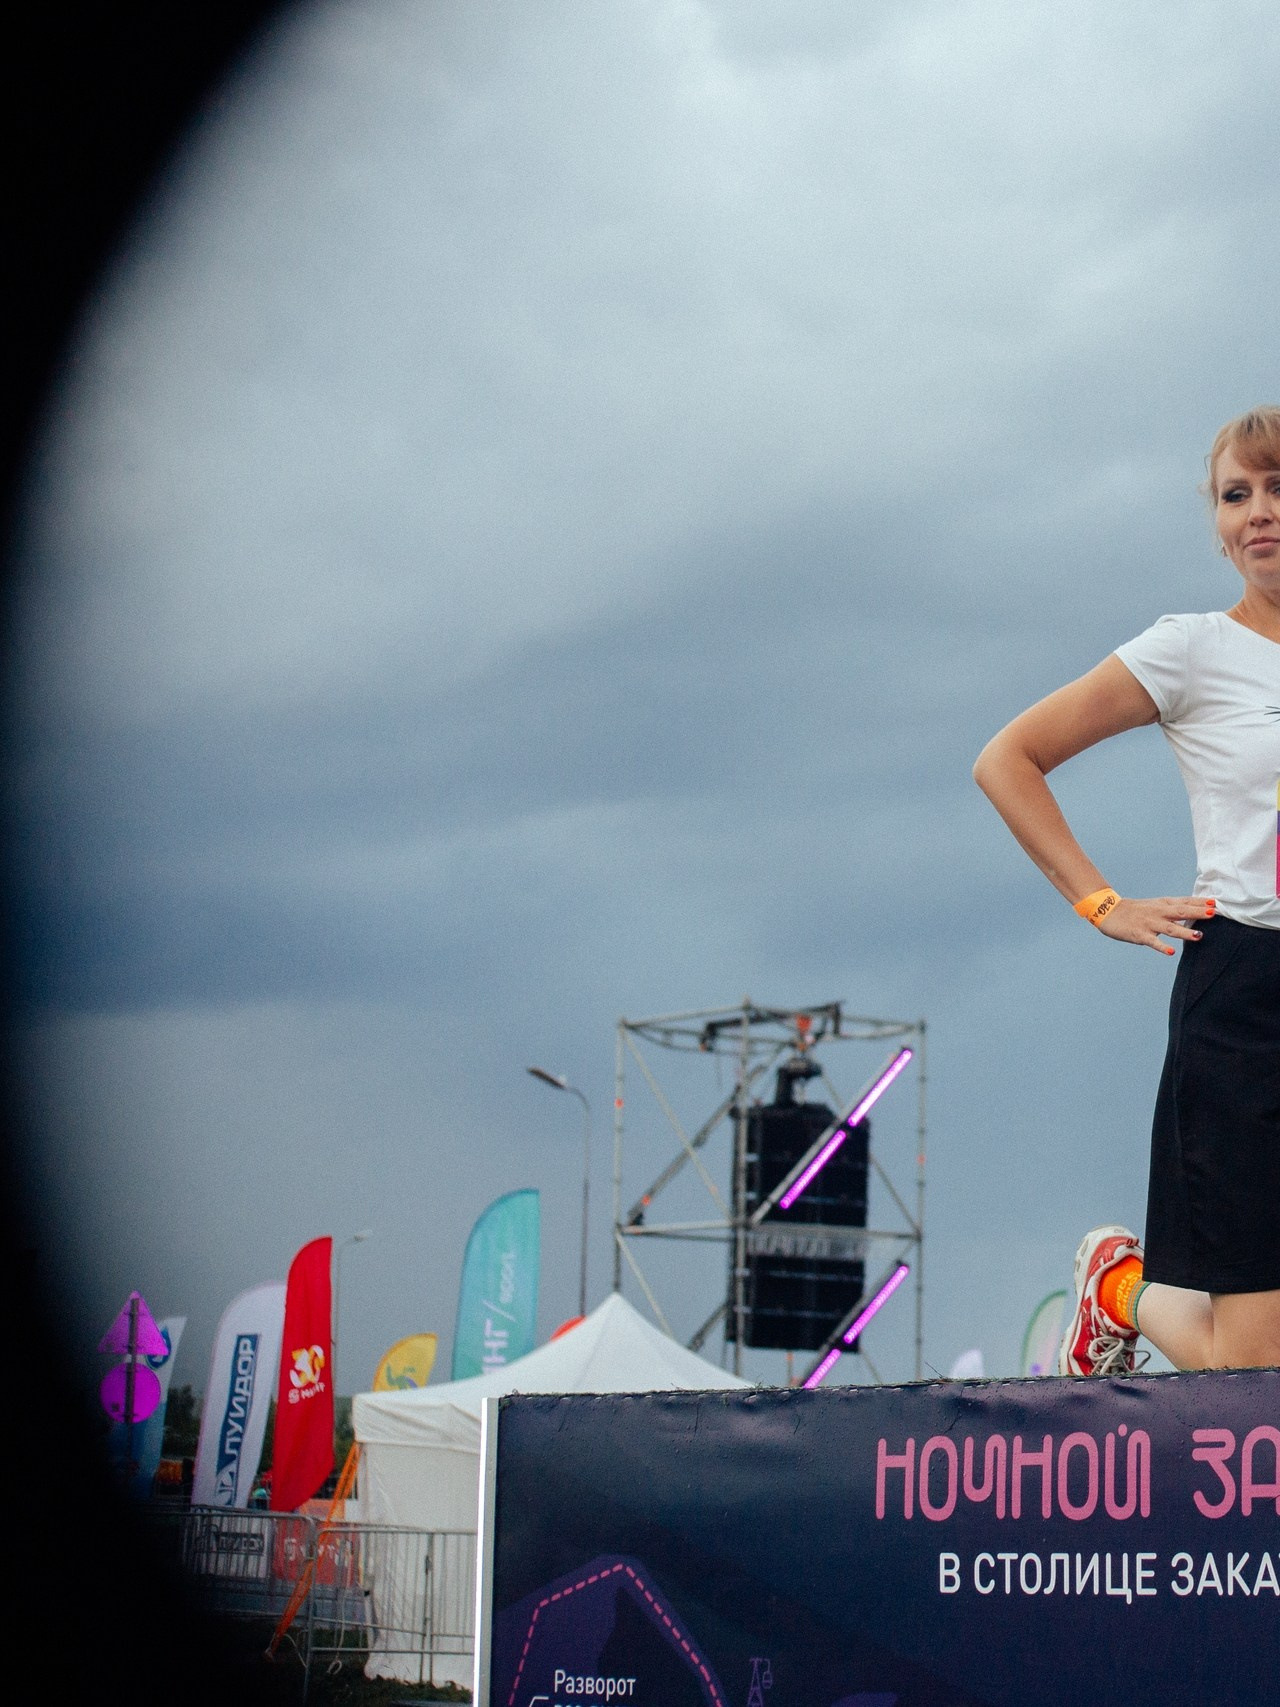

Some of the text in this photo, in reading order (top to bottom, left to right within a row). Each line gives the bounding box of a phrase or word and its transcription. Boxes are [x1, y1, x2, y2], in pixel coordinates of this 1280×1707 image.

[224, 1337, 257, 1457] ЛУИДОР
[876, 1424, 1151, 1521] НОЧНОЙ
[939, 1552, 961, 1594] В
[974, 1552, 1157, 1604] СТОЛИЦЕ
[554, 1669, 636, 1702] Разворот
